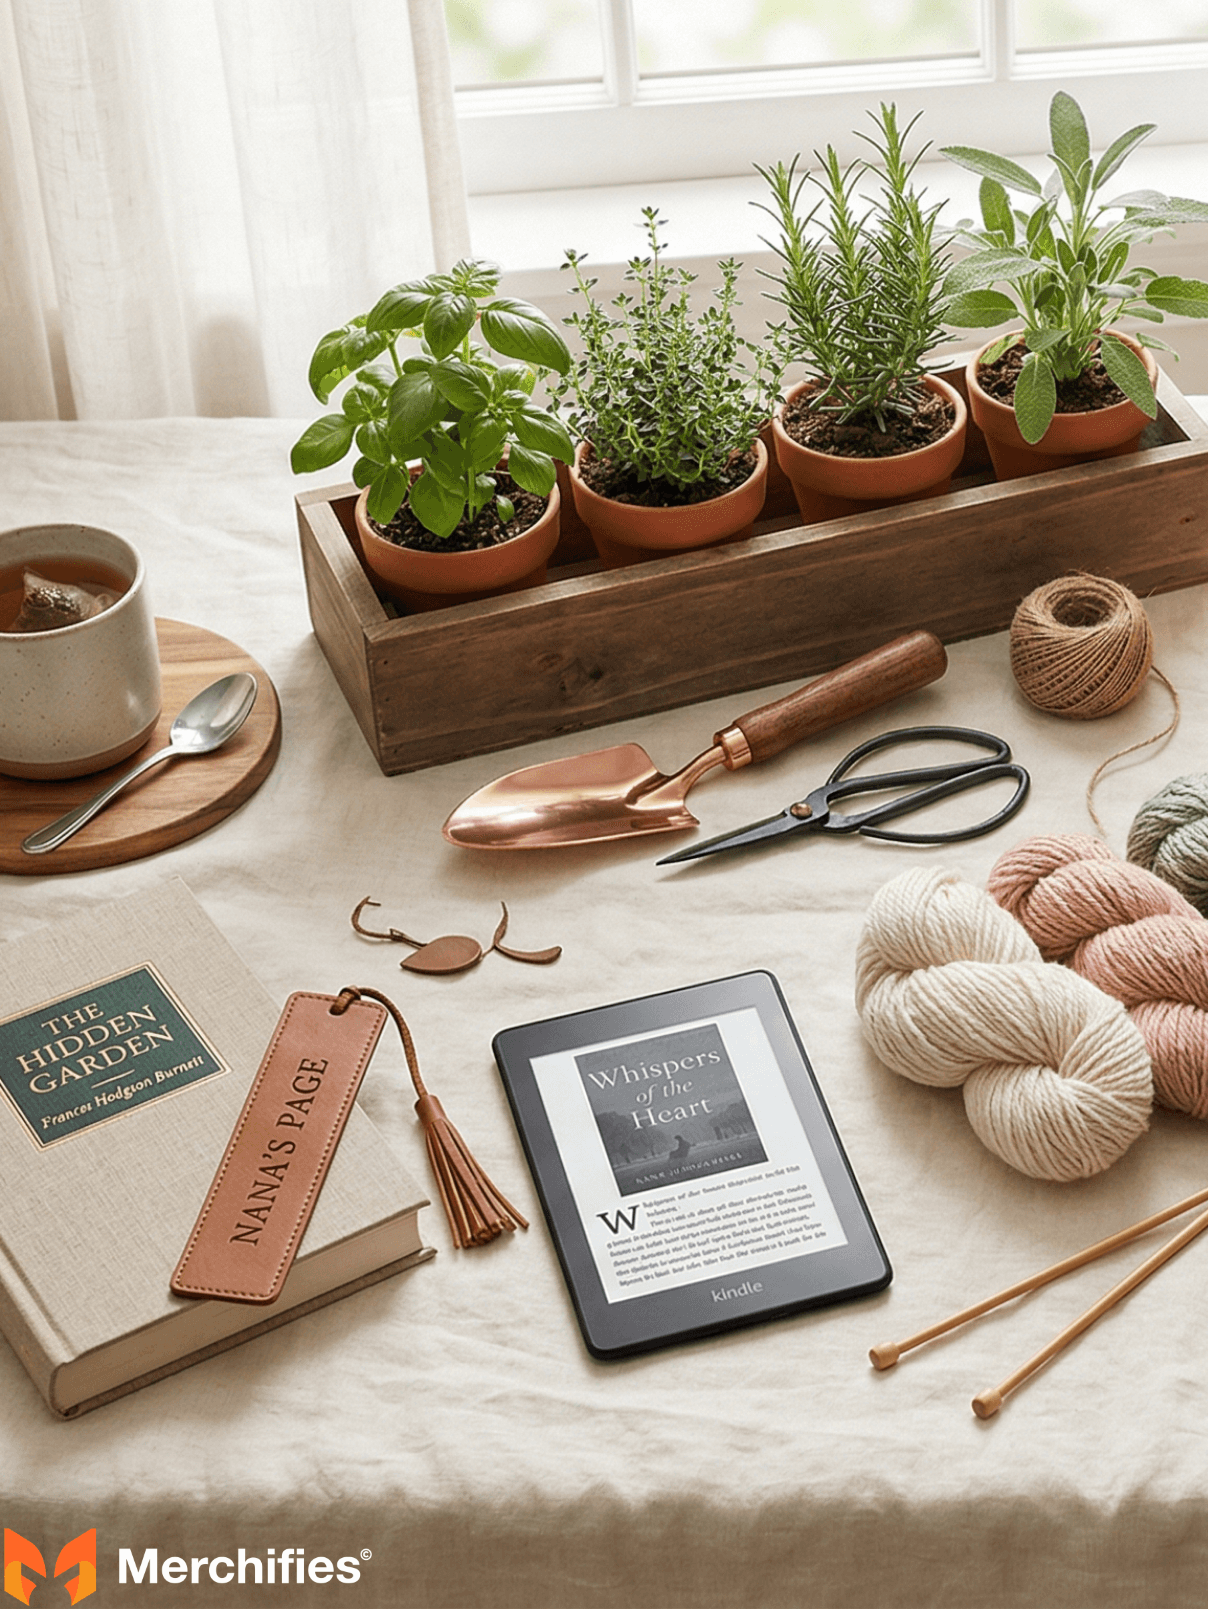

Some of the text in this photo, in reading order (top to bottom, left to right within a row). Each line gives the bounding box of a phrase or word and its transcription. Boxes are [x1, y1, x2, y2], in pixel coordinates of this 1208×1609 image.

[16, 1004, 157, 1074] HIDDEN
[41, 1003, 104, 1035] THE
[29, 1024, 174, 1094] GARDEN
[588, 1050, 721, 1090] Whispers
[41, 1102, 93, 1129] Frances
[94, 1078, 153, 1107] Hodgson
[636, 1080, 693, 1106] of the
[631, 1099, 713, 1130] Heart
[228, 1057, 329, 1247] NANA'S PAGE
[711, 1280, 764, 1303] kindle
